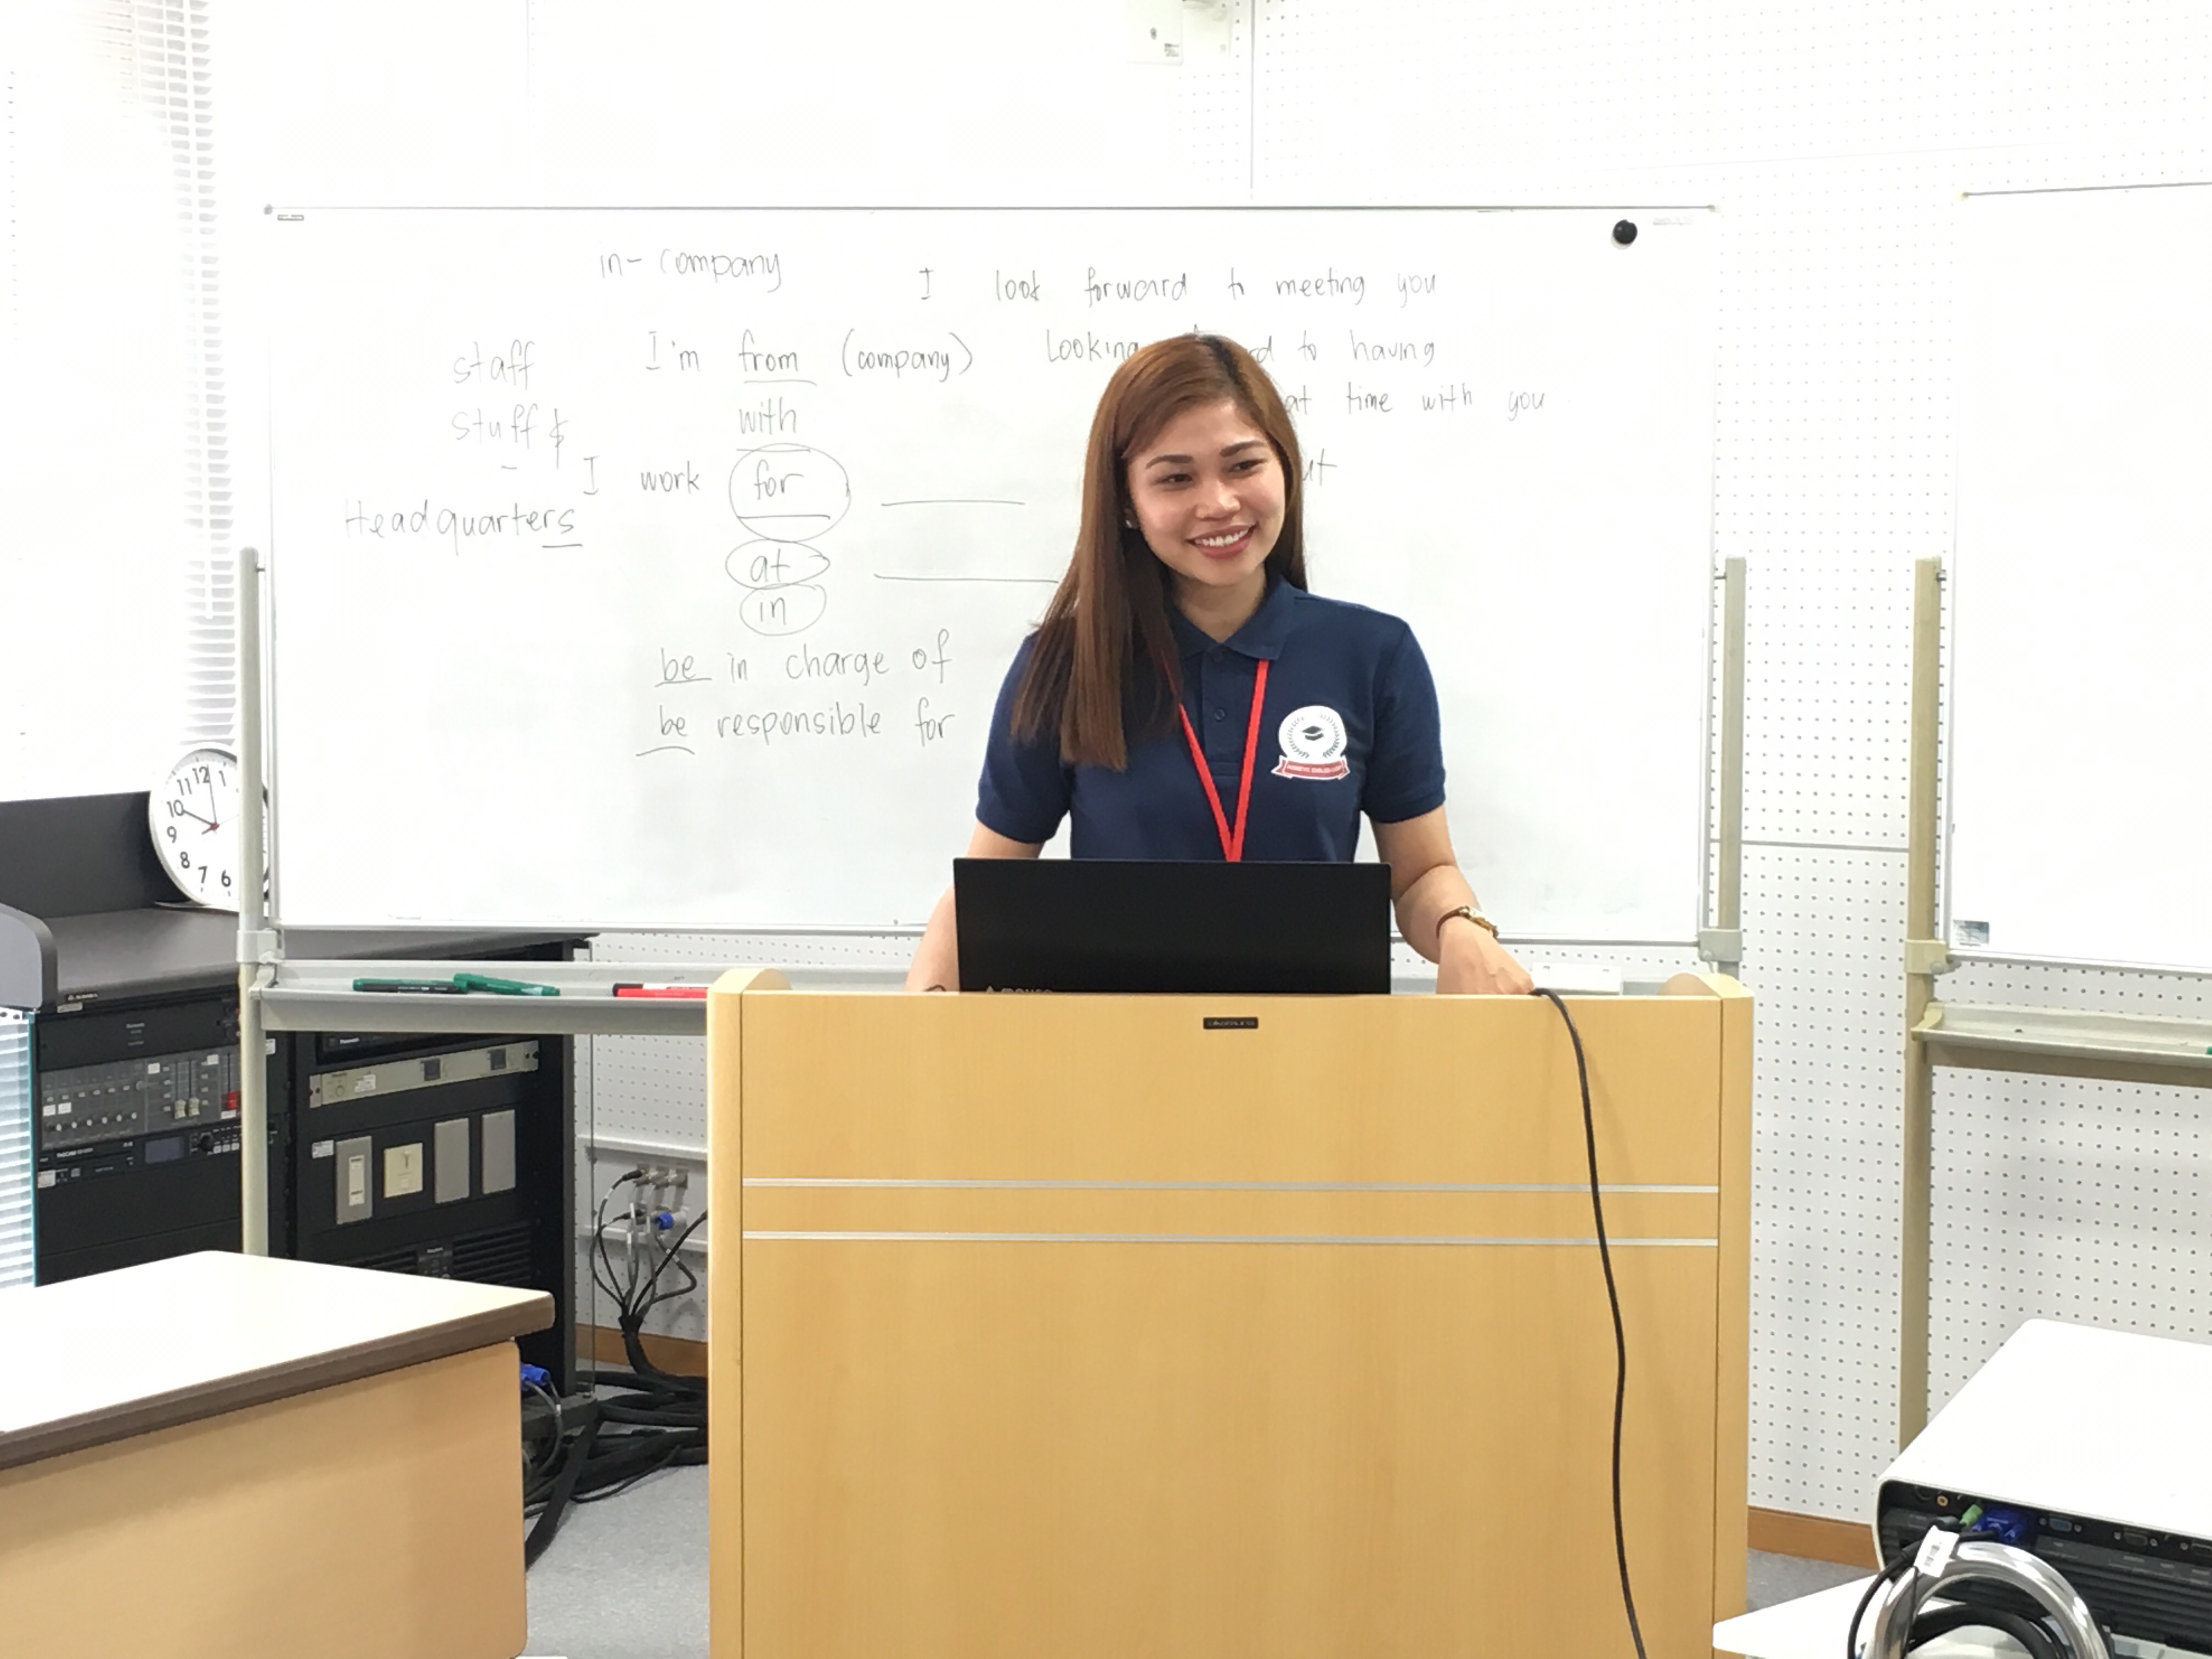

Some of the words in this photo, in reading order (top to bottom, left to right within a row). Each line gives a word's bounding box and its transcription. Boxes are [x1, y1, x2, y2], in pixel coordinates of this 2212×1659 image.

[918, 266, 935, 301] I
[995, 269, 1041, 302] look
[1275, 267, 1365, 306] meeting
[1397, 273, 1436, 308] you
[453, 338, 536, 390] staff
[645, 330, 701, 372] I'm
[738, 328, 799, 373] from
[1297, 329, 1317, 361] to
[1349, 329, 1435, 368] having
[738, 396, 797, 436] with
[1346, 381, 1393, 415] time
[1421, 382, 1472, 412] with
[1508, 391, 1545, 422] you
[582, 455, 601, 496] I
[640, 460, 701, 495] work
[753, 459, 805, 501] for
[749, 548, 791, 583] at
[759, 596, 787, 626] in
[660, 647, 698, 682] be
[726, 652, 748, 684] in
[785, 643, 890, 687] charge
[911, 628, 953, 685] of
[659, 704, 689, 737] be
[716, 701, 881, 746] responsible
[914, 696, 956, 748] for
[177, 777, 192, 796] 11
[192, 766, 210, 784] 12
[219, 770, 226, 787] 1
[166, 799, 184, 818] 10
[166, 825, 177, 843] 9
[179, 851, 190, 869] 8
[198, 865, 208, 884] 7
[221, 870, 232, 887] 6
